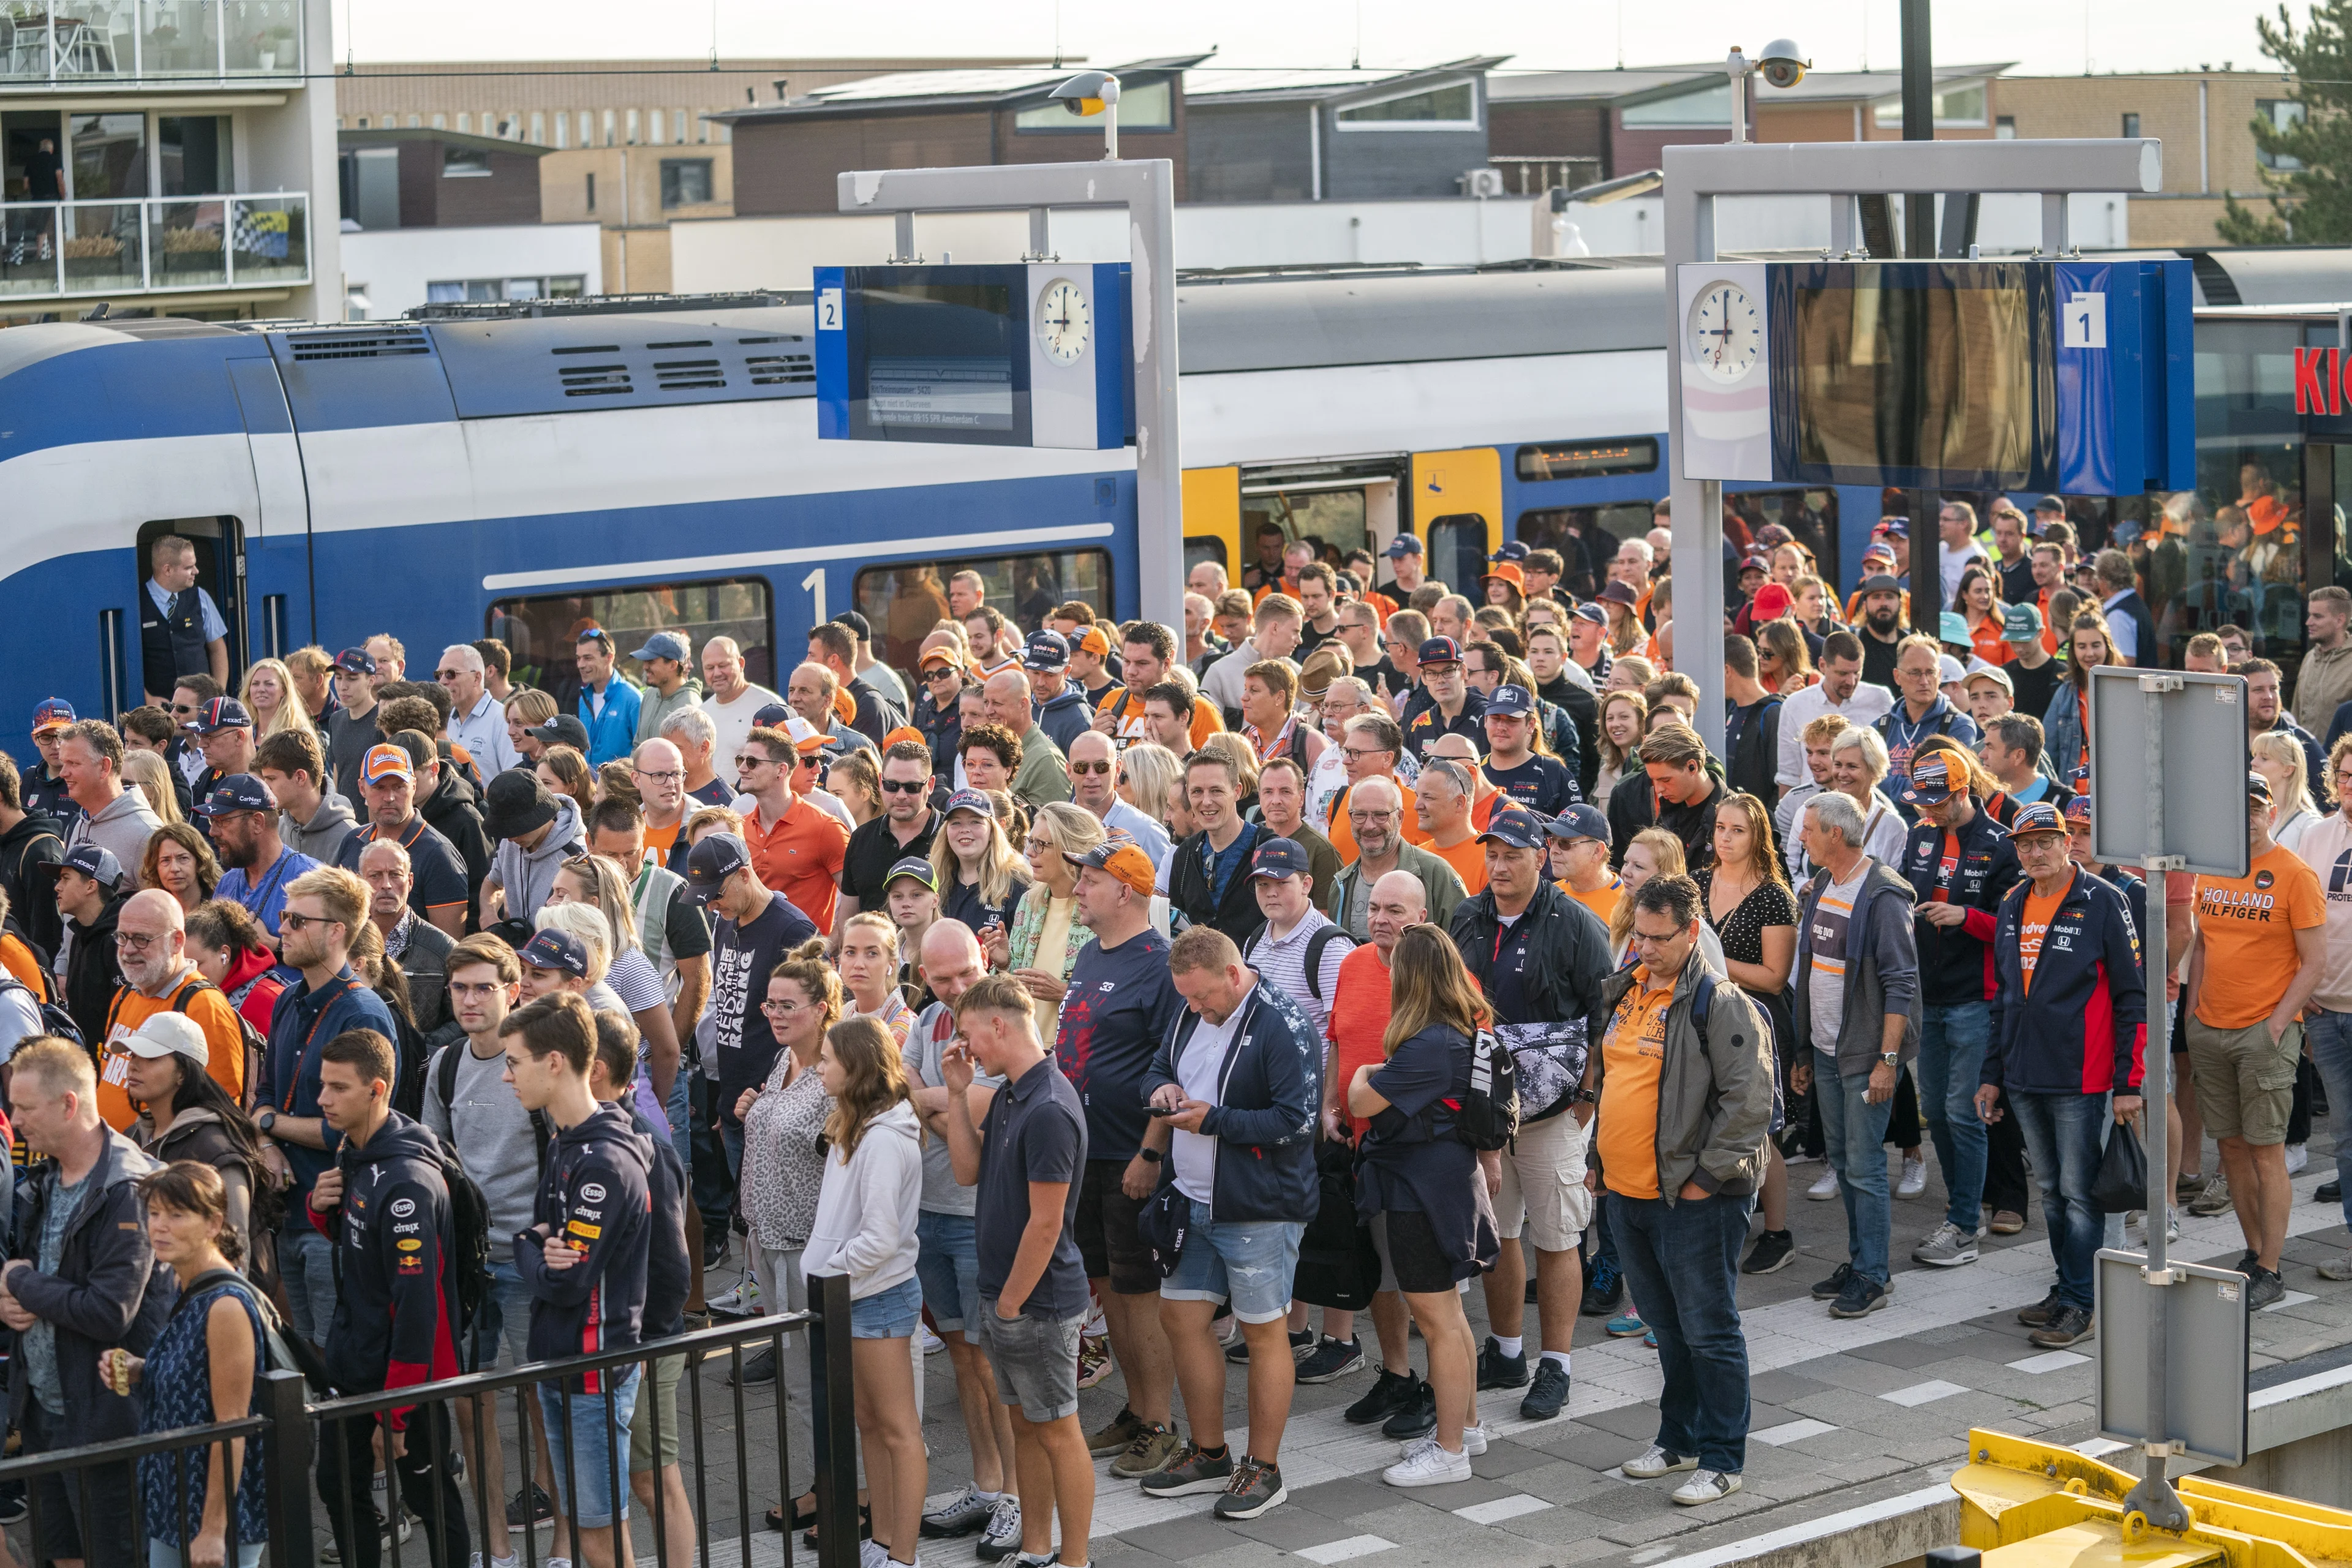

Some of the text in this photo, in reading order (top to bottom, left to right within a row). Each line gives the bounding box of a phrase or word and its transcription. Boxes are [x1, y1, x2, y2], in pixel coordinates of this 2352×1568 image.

[826, 303, 835, 325] 2
[2078, 313, 2090, 343] 1
[801, 568, 826, 627] 1
[2203, 887, 2275, 910] HOLLAND
[2199, 902, 2271, 922] HILFIGER
[2054, 925, 2073, 935] Mobil
[564, 953, 583, 969] CarNext
[1099, 981, 1115, 992] 33
[729, 951, 753, 1049] RACING
